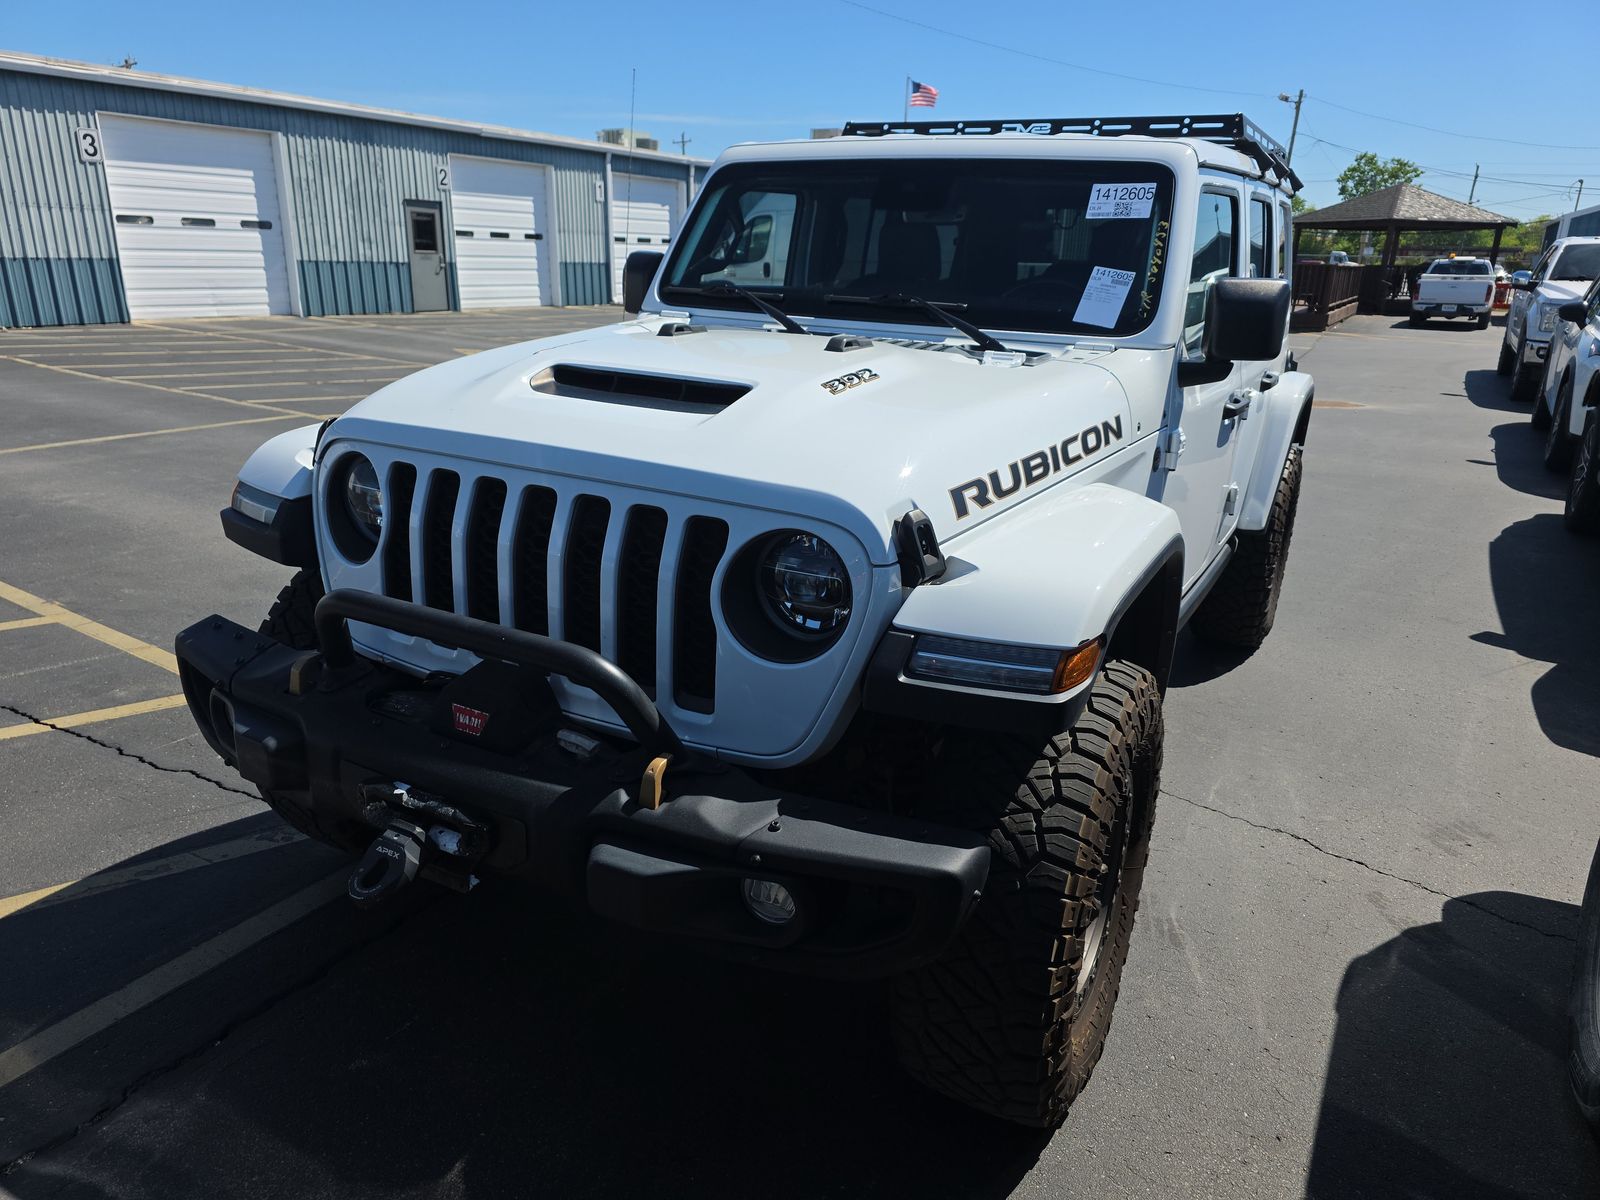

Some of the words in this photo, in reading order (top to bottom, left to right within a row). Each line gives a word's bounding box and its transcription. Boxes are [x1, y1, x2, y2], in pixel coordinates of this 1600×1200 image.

[82, 133, 98, 157] 3
[439, 168, 449, 186] 2
[1095, 187, 1155, 200] 1412605
[1094, 268, 1135, 282] 1412605
[820, 368, 880, 396] 392
[948, 414, 1123, 521] RUBICON
[375, 846, 400, 860] APEX
